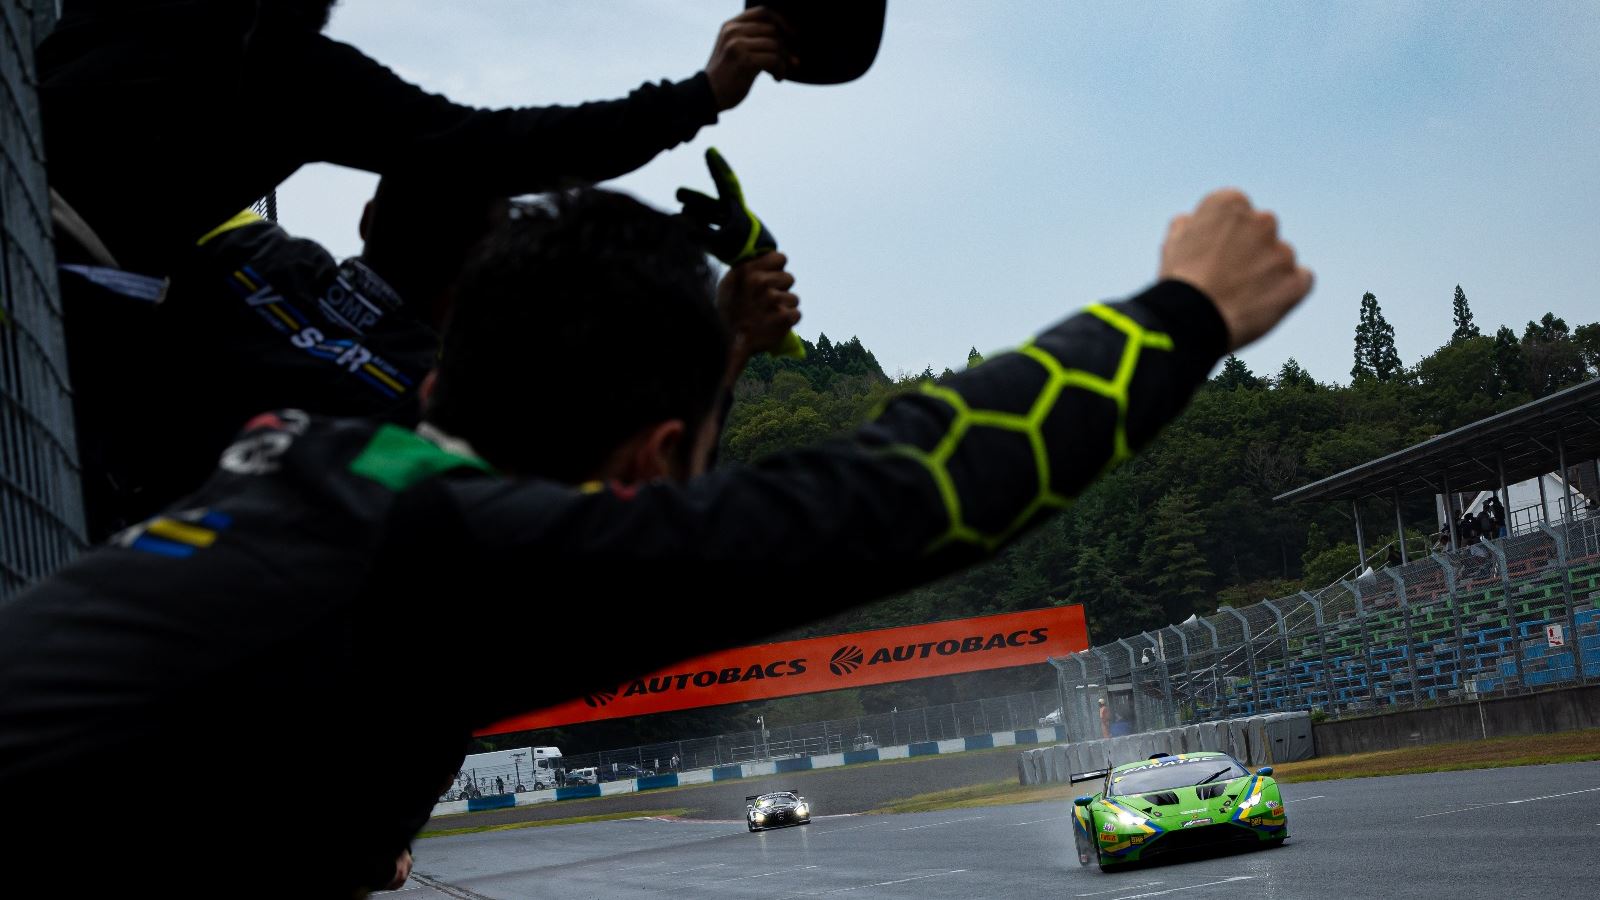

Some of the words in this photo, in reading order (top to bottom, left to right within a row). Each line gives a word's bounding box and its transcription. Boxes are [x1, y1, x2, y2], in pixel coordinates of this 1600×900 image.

[327, 284, 377, 327] OMP
[623, 658, 807, 697] AUTOBACS
[867, 627, 1049, 666] AUTOBACS
